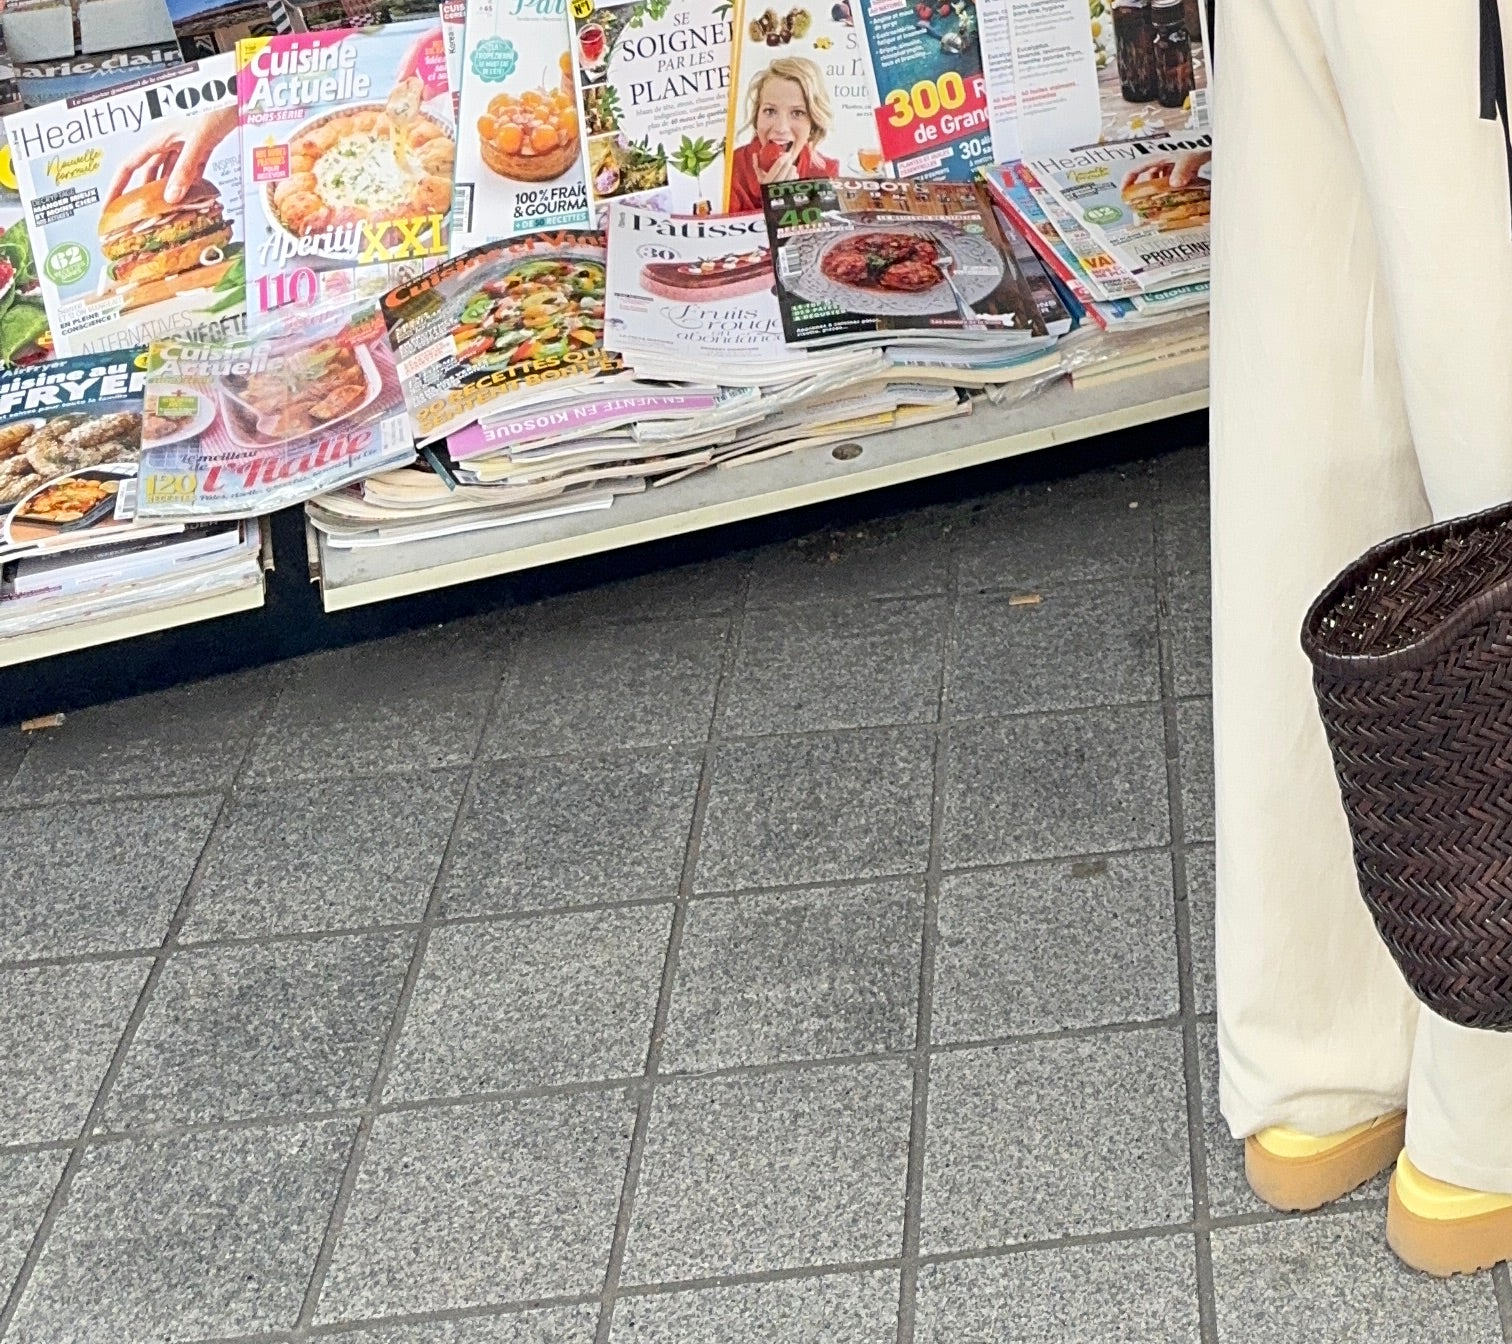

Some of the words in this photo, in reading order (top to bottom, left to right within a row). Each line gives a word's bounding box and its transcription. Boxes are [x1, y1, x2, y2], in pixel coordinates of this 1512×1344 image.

[673, 11, 690, 26] SE
[250, 40, 356, 79] Cuisine
[658, 55, 688, 73] PAR
[690, 50, 714, 66] LES
[248, 70, 370, 109] Actuelle
[885, 71, 966, 127] 300
[914, 123, 938, 143] de
[254, 266, 317, 312] 110
